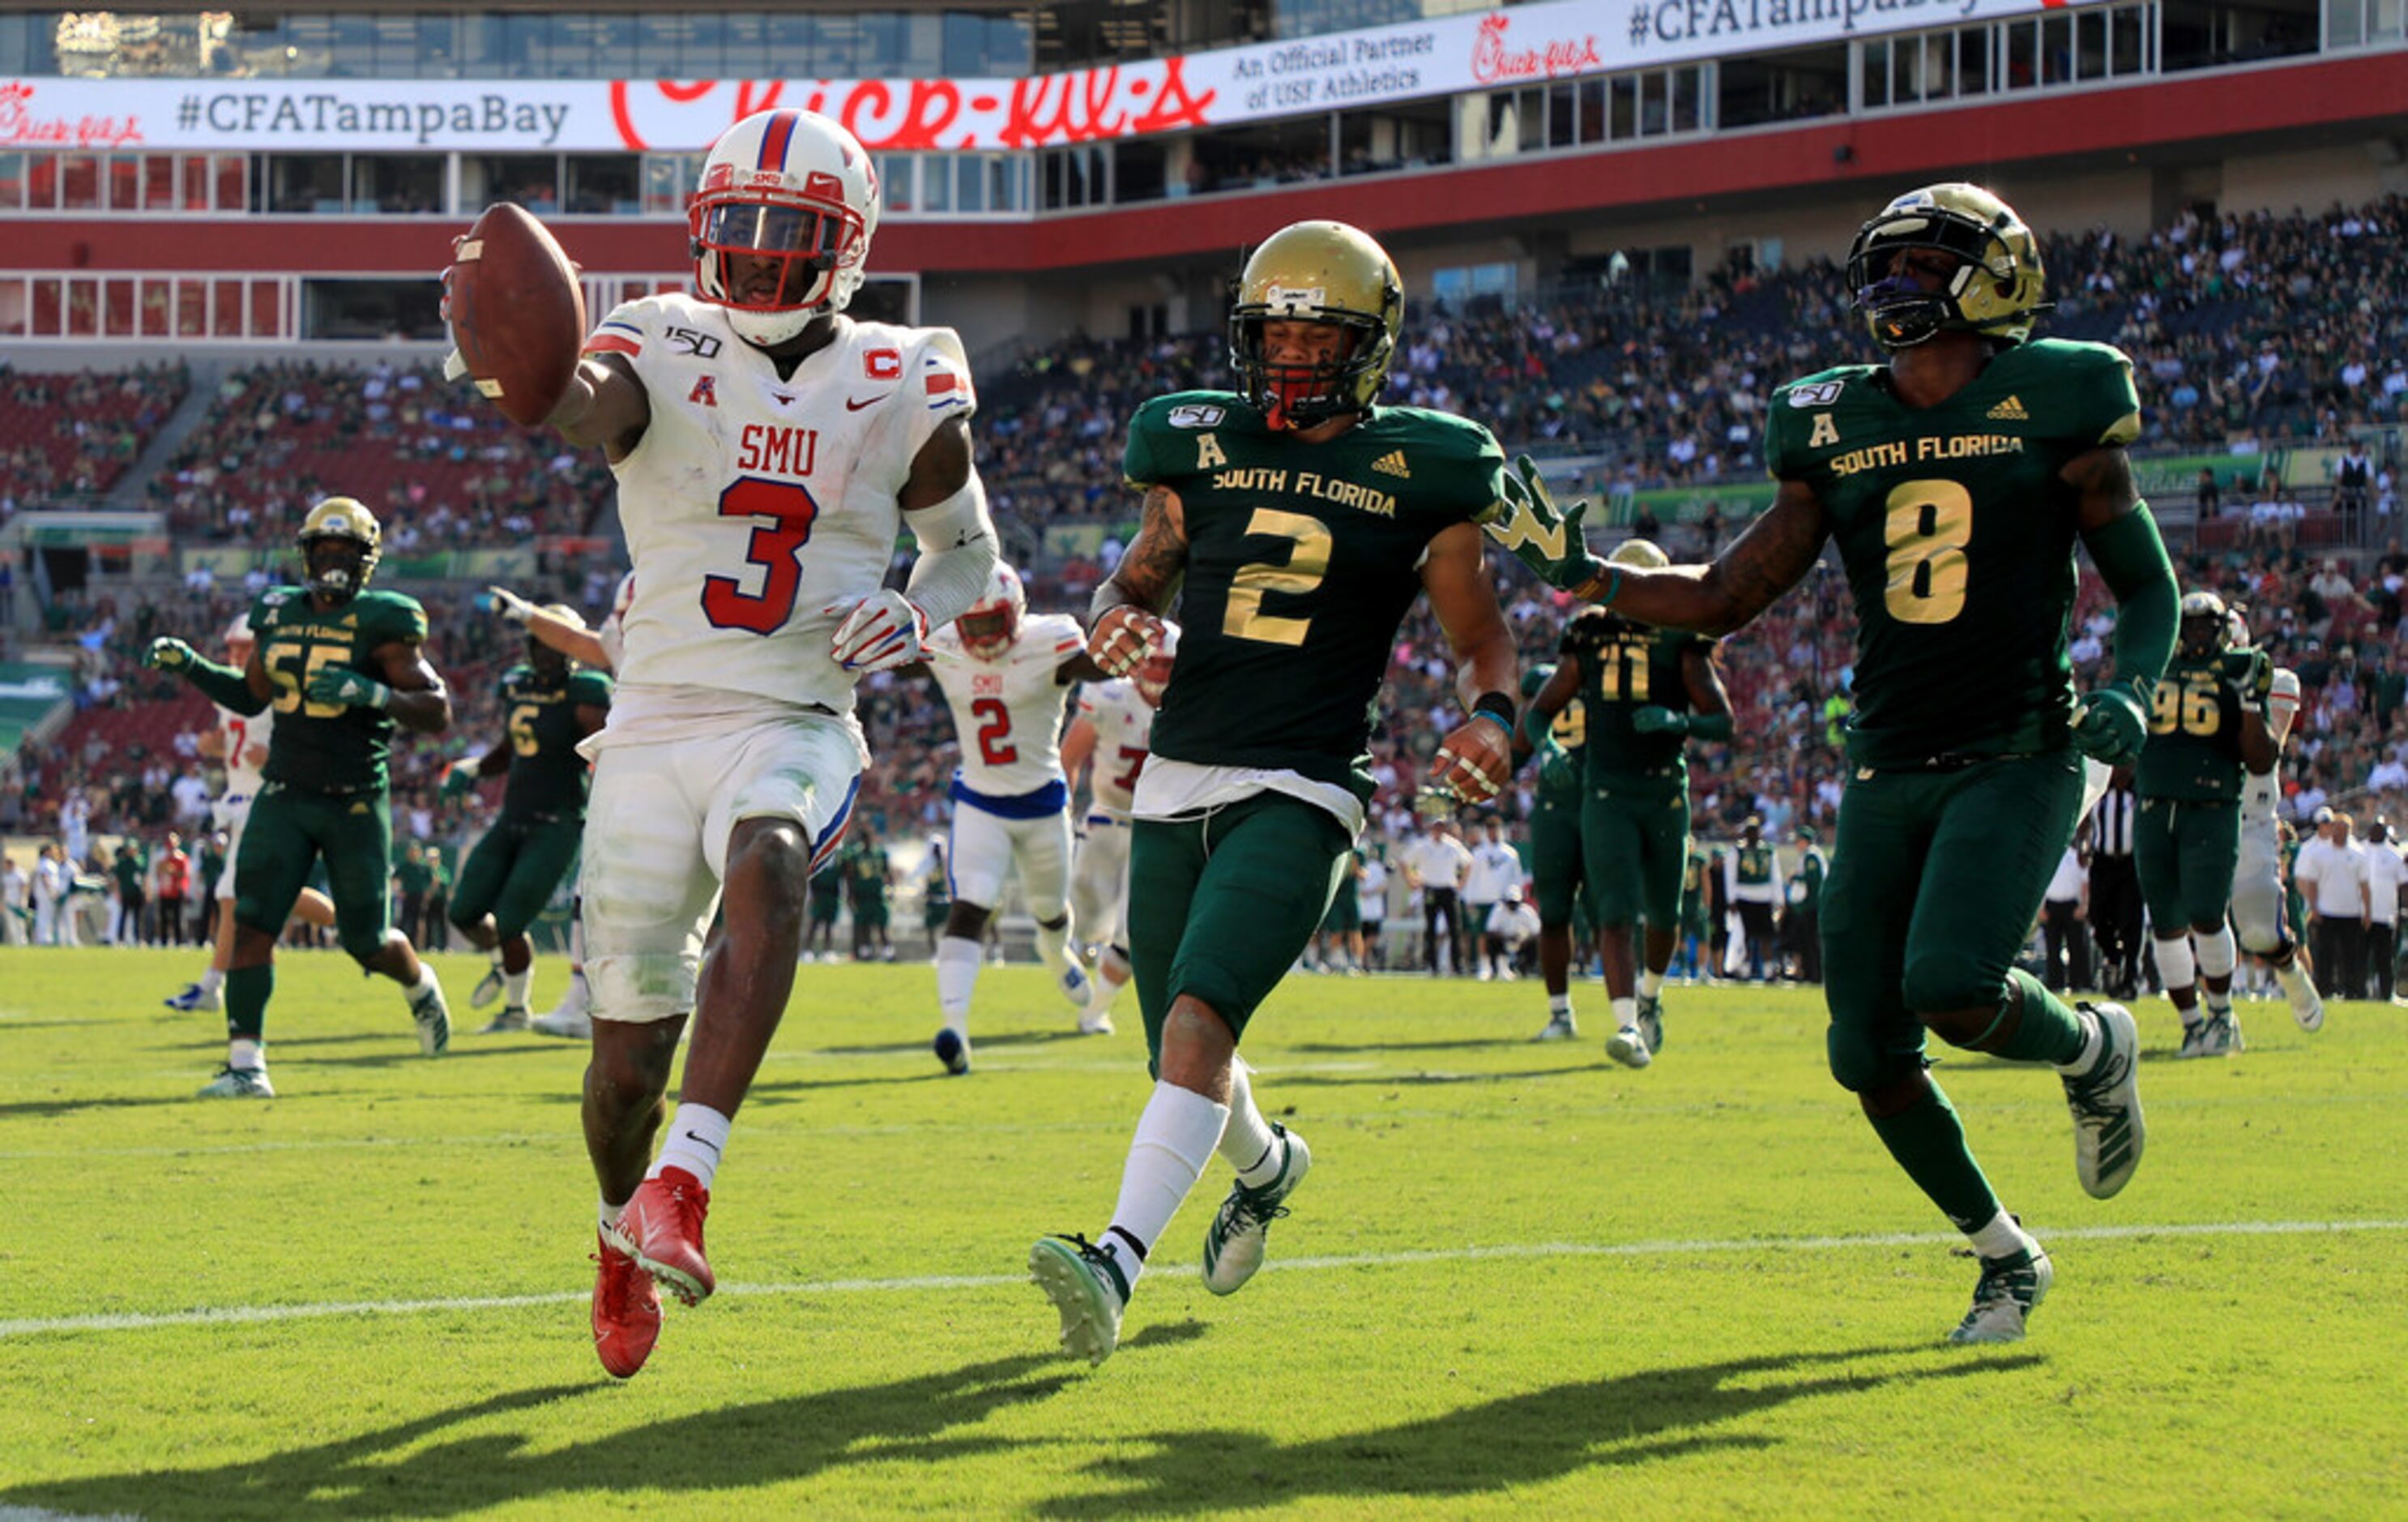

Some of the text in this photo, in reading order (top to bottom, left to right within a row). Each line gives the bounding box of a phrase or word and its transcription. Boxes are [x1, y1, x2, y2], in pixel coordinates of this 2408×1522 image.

[1233, 33, 1434, 79] An Official Partner
[1248, 83, 1268, 109] of
[1321, 66, 1421, 100] Athletics
[177, 93, 570, 144] #CFATampaBay
[754, 173, 782, 185] SMU
[664, 326, 723, 359] 150
[864, 348, 902, 380] C
[737, 423, 818, 477] SMU
[1829, 434, 2024, 477] SOUTH FLORIDA
[1212, 466, 1397, 519] SOUTH FLORIDA
[700, 474, 819, 638] 3
[1221, 507, 1333, 647] 2
[1885, 478, 1972, 624] 8
[265, 643, 352, 719] 55
[972, 673, 1003, 695] SMU
[1596, 643, 1650, 701] 11
[510, 703, 540, 758] 6
[971, 698, 1018, 766] 2
[2147, 681, 2221, 737] 96
[229, 718, 247, 770] 7
